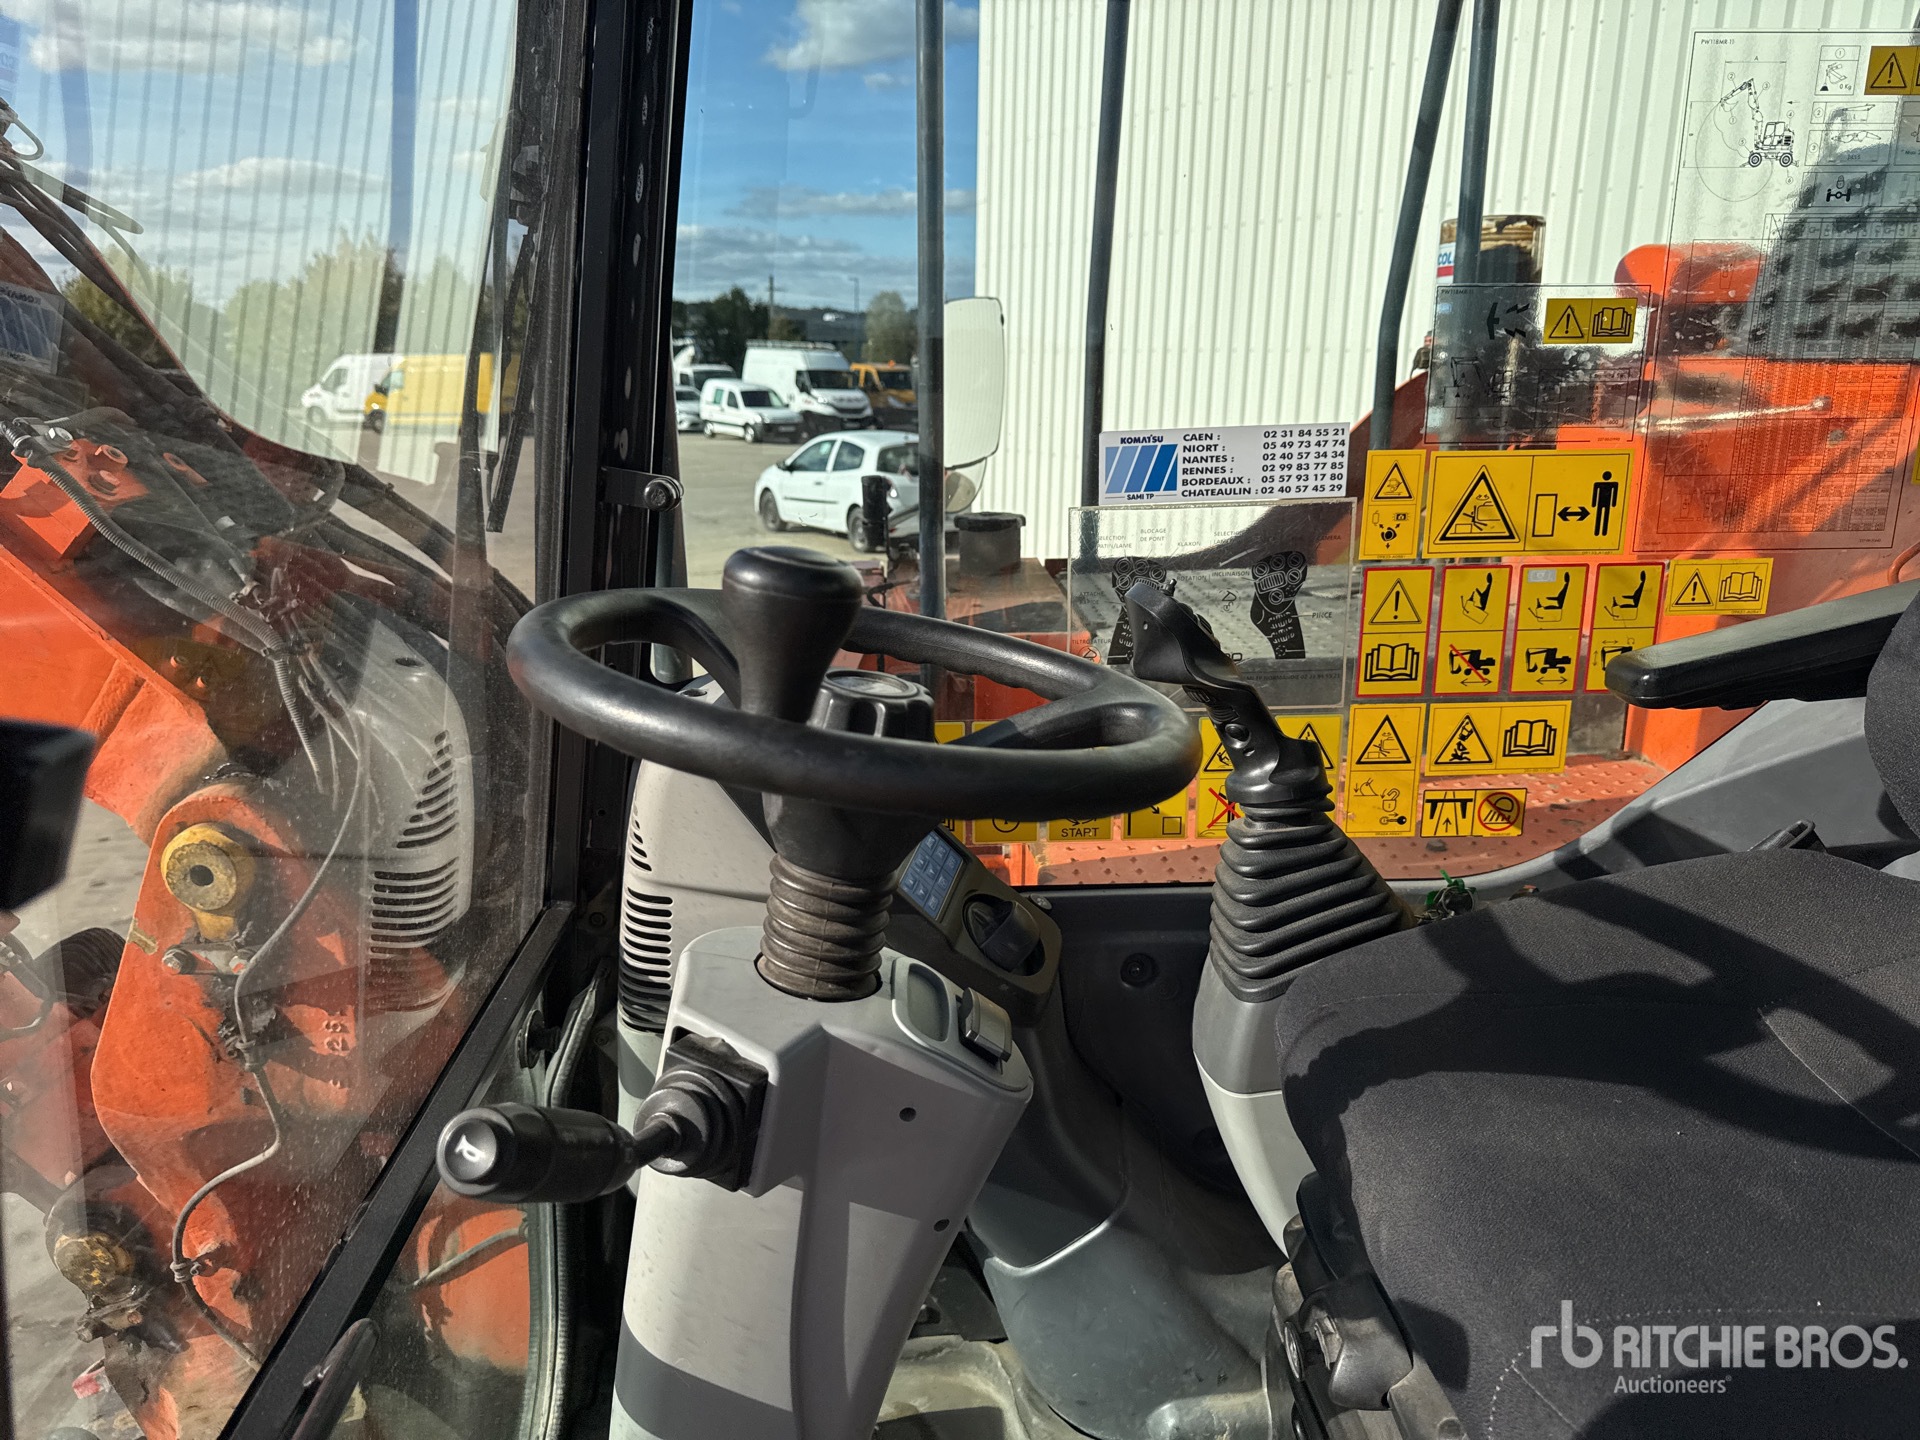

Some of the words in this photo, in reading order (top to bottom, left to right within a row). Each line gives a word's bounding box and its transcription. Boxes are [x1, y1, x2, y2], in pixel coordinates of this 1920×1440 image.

[1120, 434, 1164, 444] KOMATSU
[1183, 433, 1213, 442] CAEN
[1298, 429, 1311, 437] 84
[1333, 428, 1345, 436] 21
[1183, 444, 1219, 453] NIORT
[1182, 455, 1228, 464] NANTES
[1182, 466, 1226, 475] RENNES
[1182, 477, 1244, 486] BORDEAUX
[1181, 487, 1251, 497] CHATEAULIN
[1061, 827, 1100, 838] START
